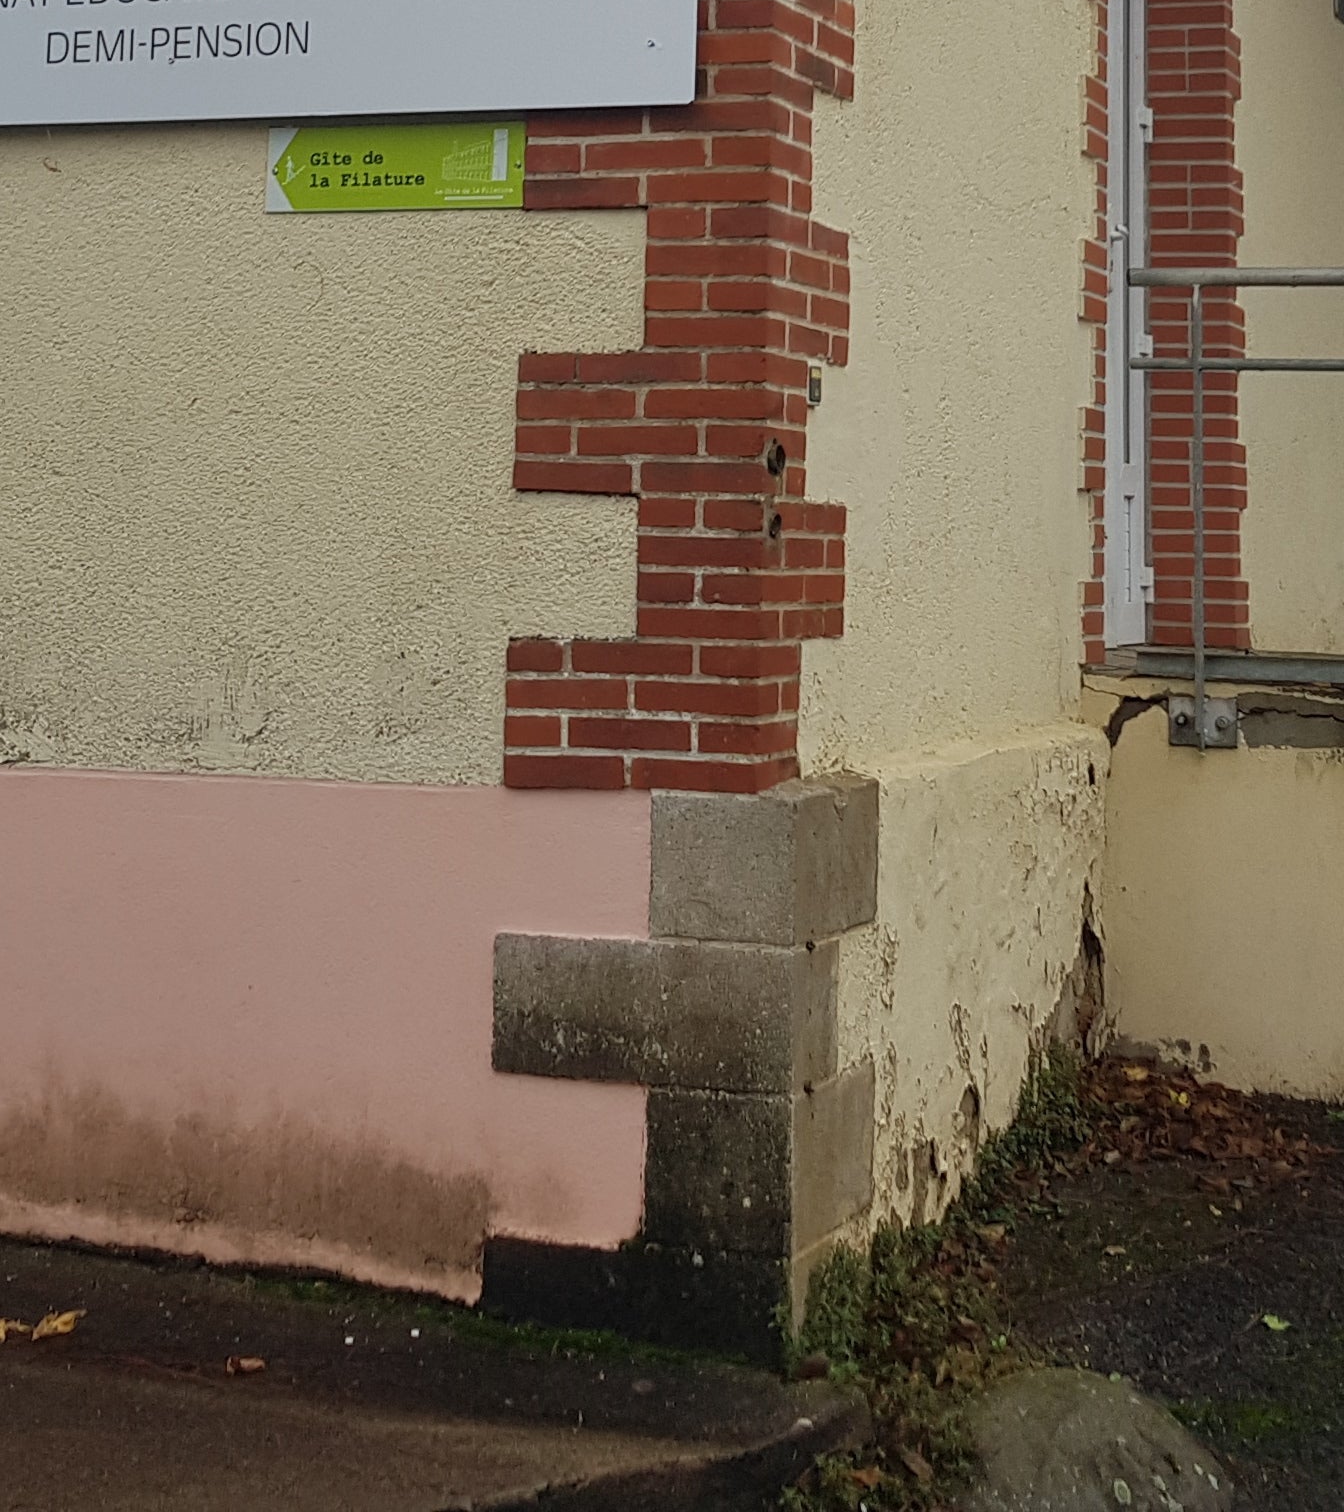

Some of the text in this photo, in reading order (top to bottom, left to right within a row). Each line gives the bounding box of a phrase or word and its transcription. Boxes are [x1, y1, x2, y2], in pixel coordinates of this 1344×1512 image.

[46, 20, 310, 65] DEMI-PENSION
[310, 150, 384, 166] Gîte de
[309, 172, 425, 188] la Filature
